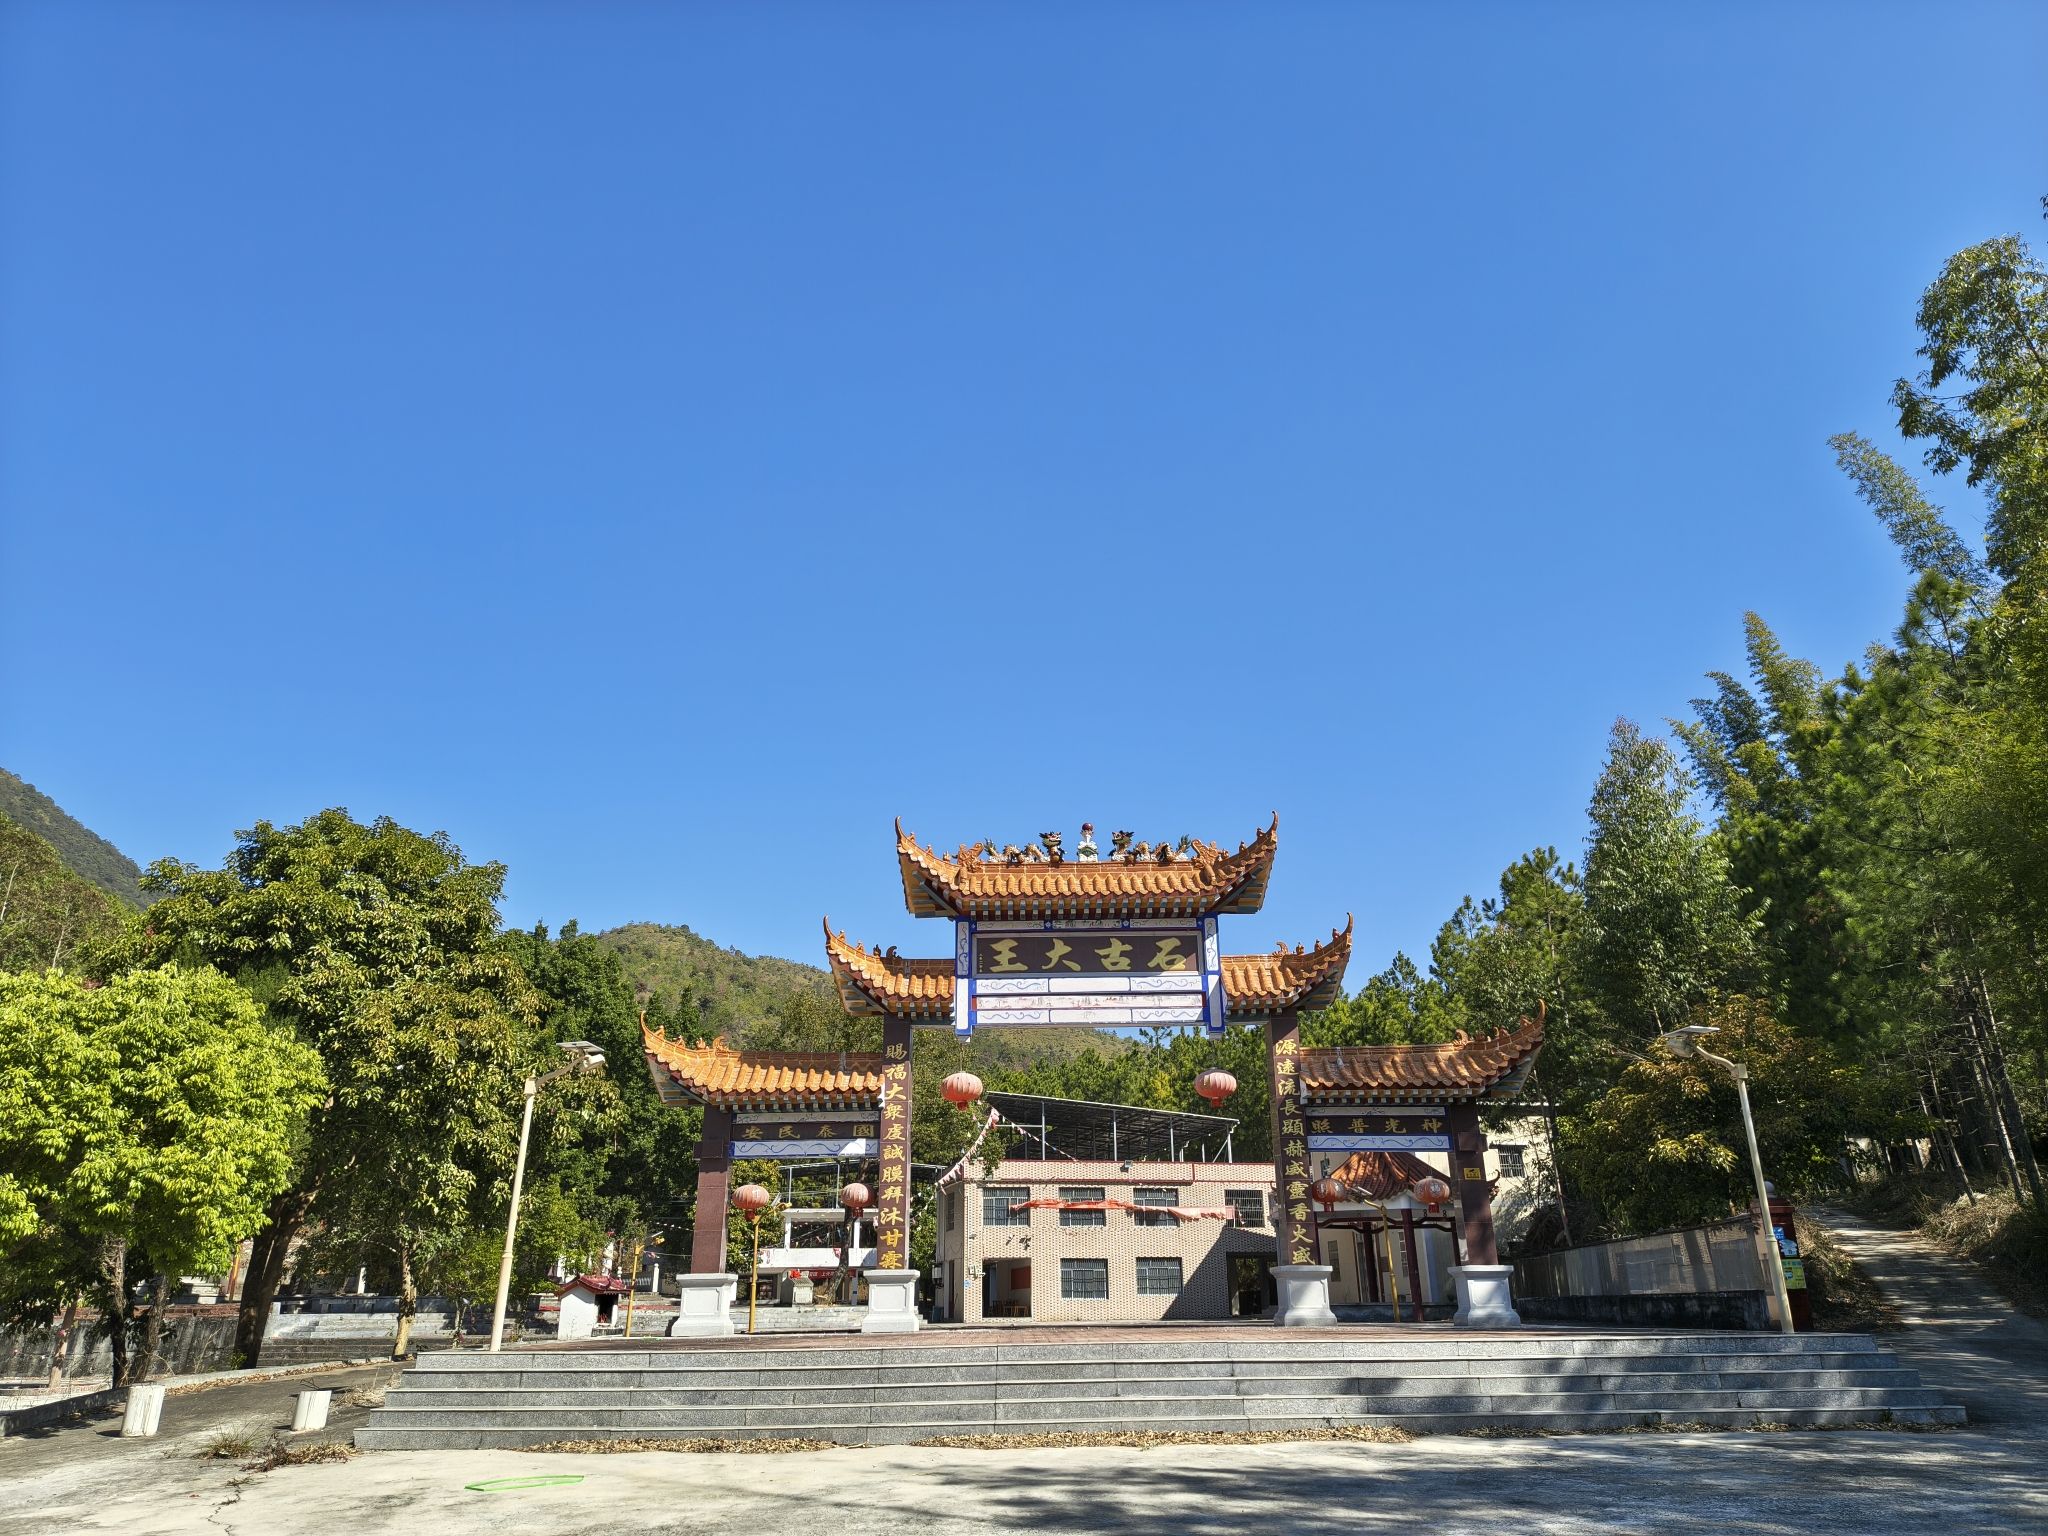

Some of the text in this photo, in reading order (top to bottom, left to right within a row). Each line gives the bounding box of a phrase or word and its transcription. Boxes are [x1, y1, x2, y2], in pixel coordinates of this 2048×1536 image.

[989, 937, 1187, 973] 石古大王
[742, 1124, 874, 1140] 國泰民安
[1311, 1118, 1443, 1134] 神光普照
